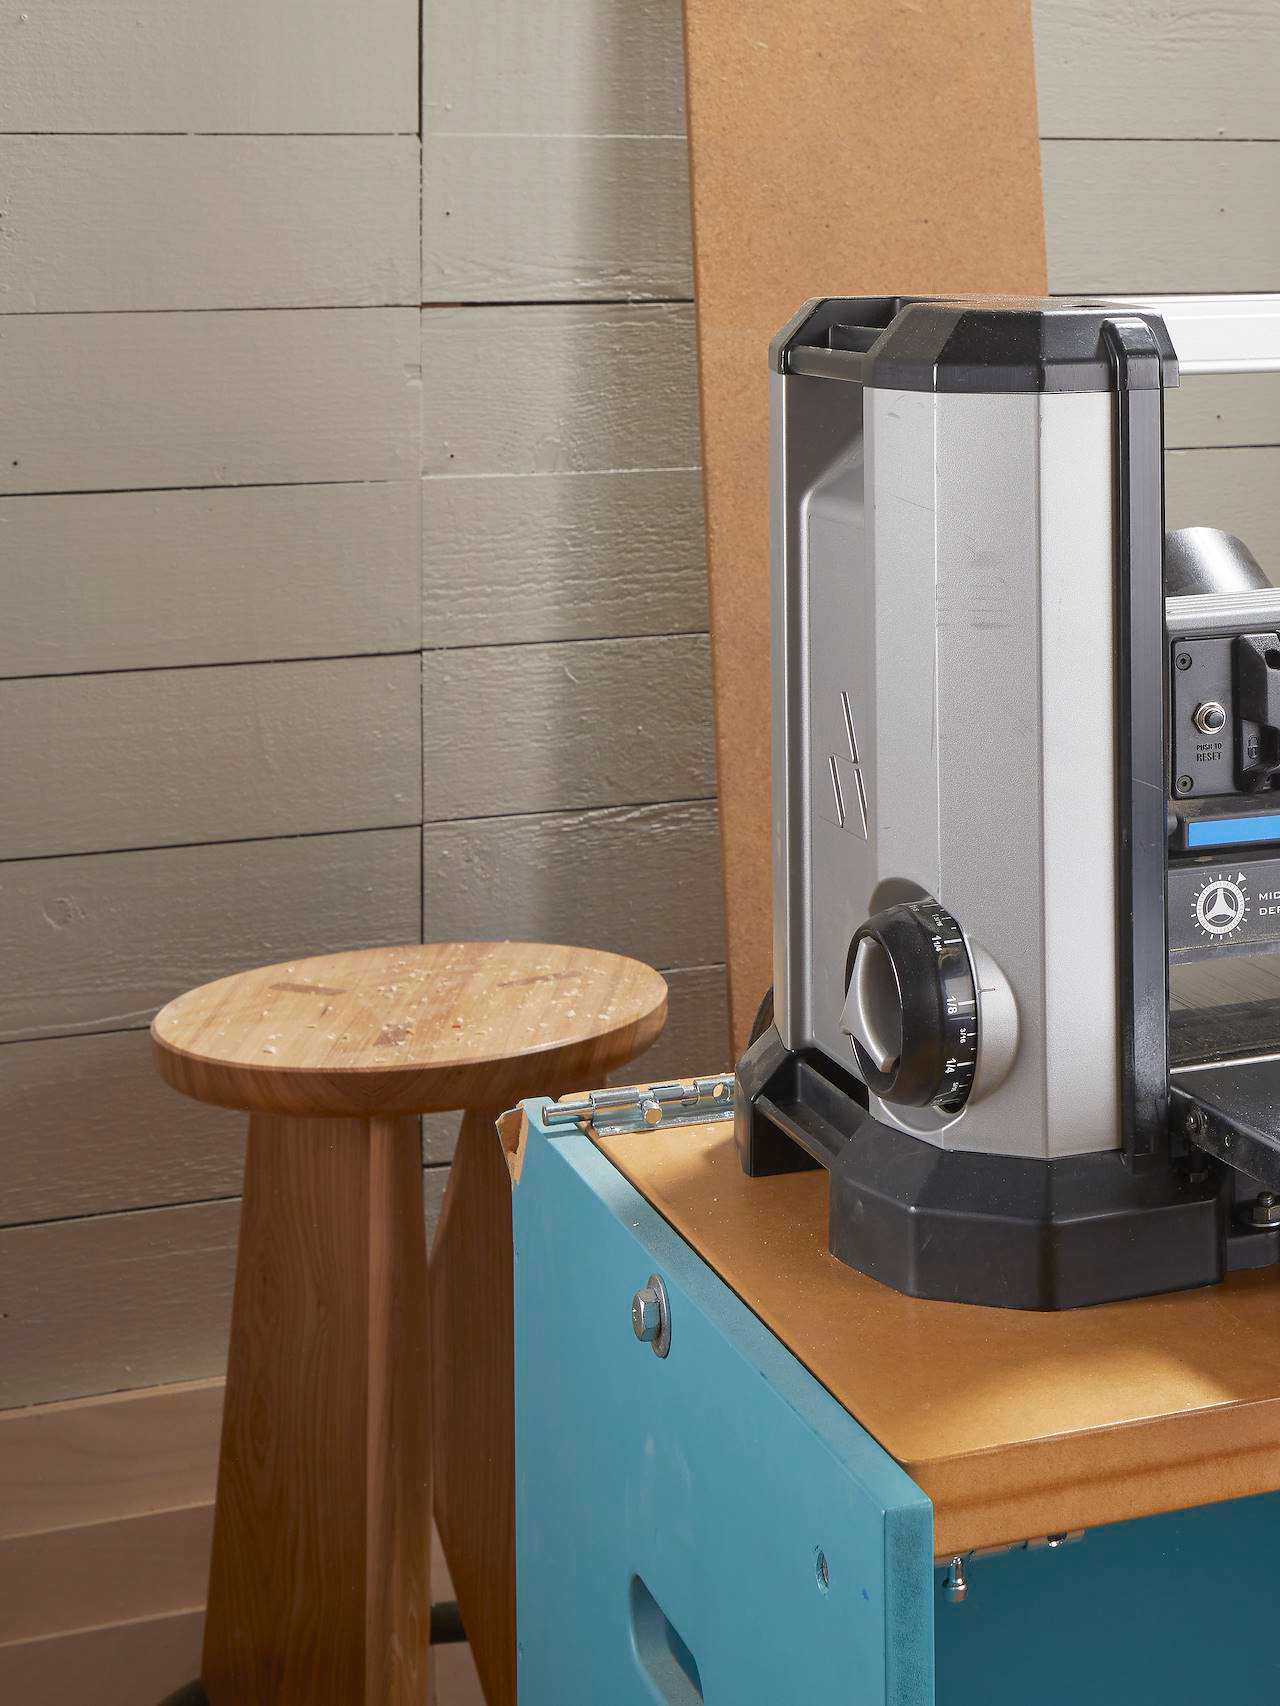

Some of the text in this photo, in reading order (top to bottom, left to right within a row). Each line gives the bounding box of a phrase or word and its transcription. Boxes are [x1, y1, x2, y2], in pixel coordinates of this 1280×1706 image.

[1196, 742, 1222, 751] PUSH TO
[1196, 751, 1222, 762] RESET
[946, 996, 958, 1014] 1/8
[959, 1027, 967, 1044] 3/16
[945, 1058, 957, 1074] 1/4
